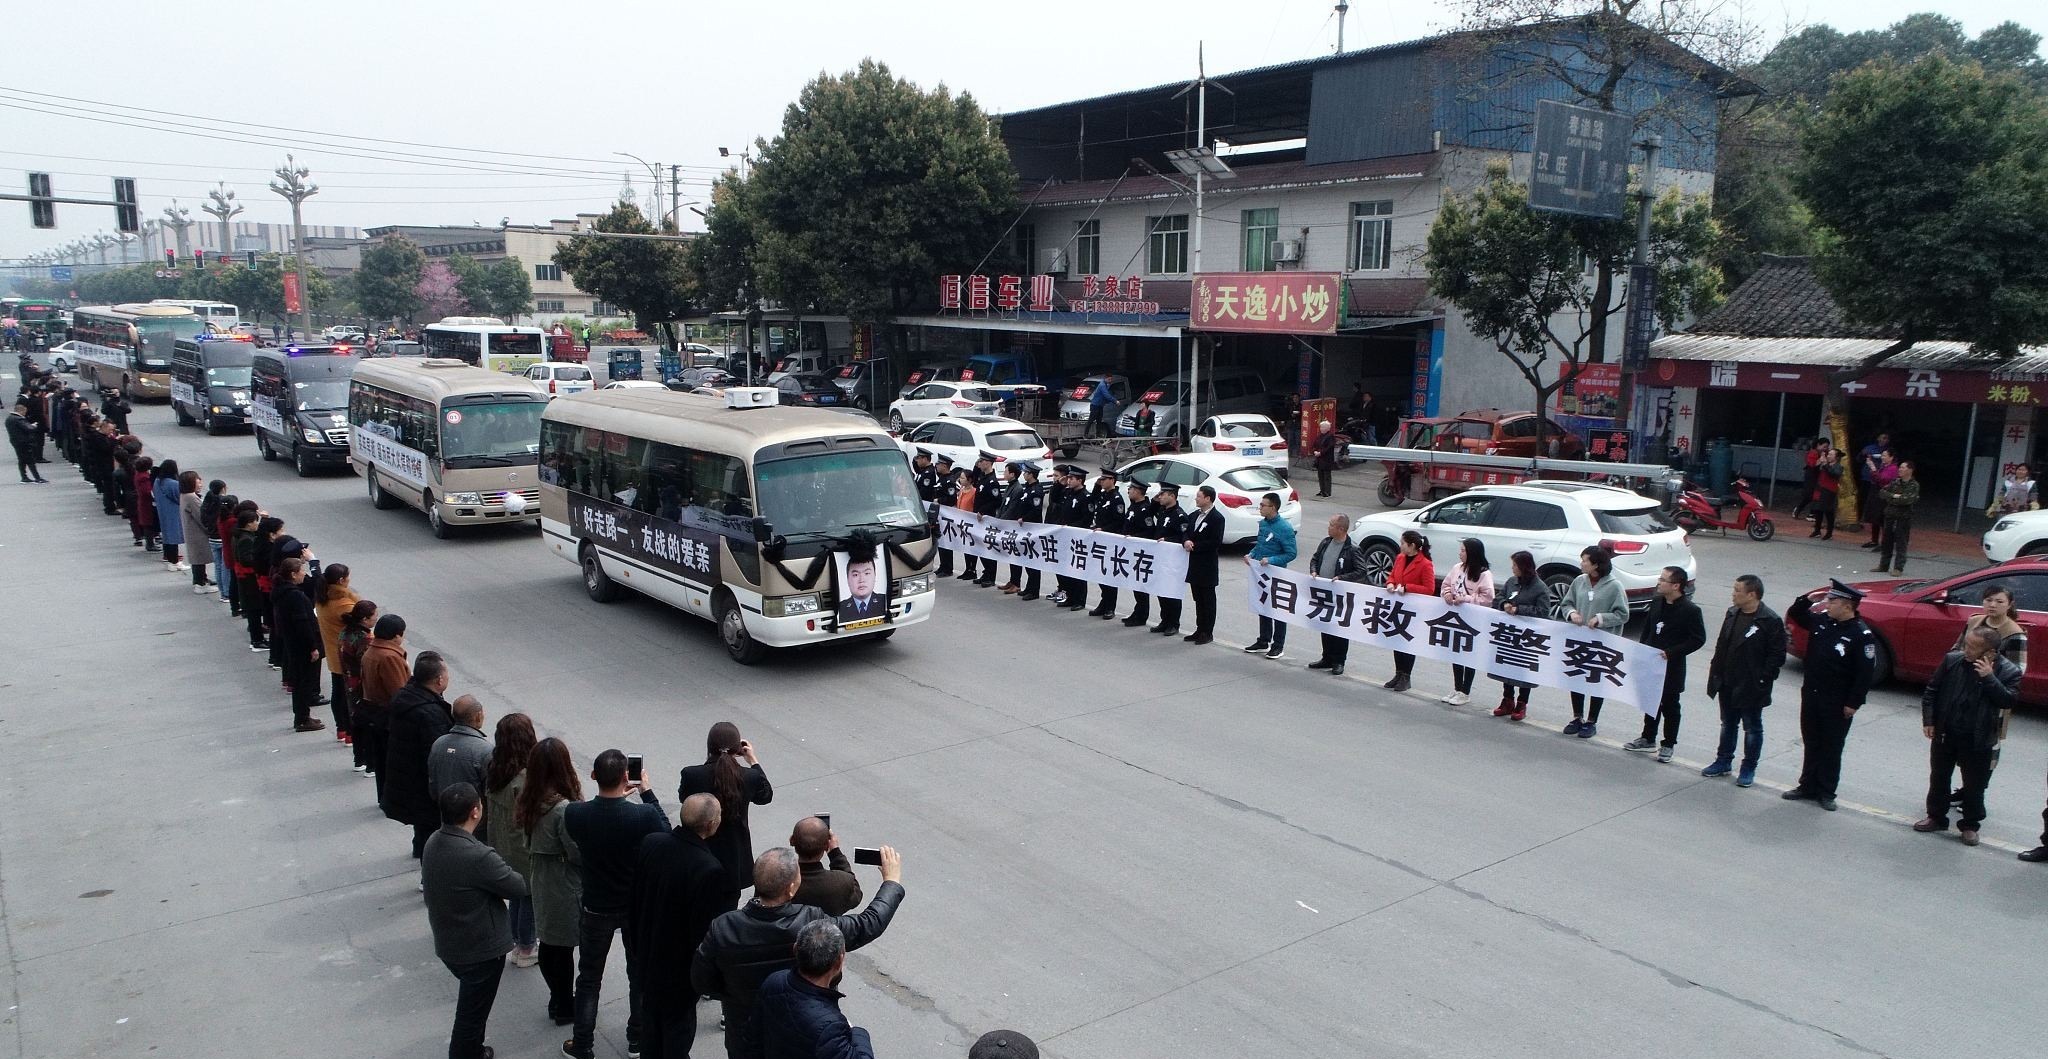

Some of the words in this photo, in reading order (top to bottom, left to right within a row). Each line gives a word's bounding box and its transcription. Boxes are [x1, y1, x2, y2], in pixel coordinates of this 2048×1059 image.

[940, 275, 1054, 311] 恒信车业
[1083, 275, 1143, 299] 形象店
[1214, 284, 1330, 323] 天逸小炒
[942, 516, 975, 547] 不朽
[983, 525, 1059, 564] 英魂永驻
[1070, 538, 1155, 584] 浩气长存
[1258, 573, 1627, 687] 泪别救命警察
